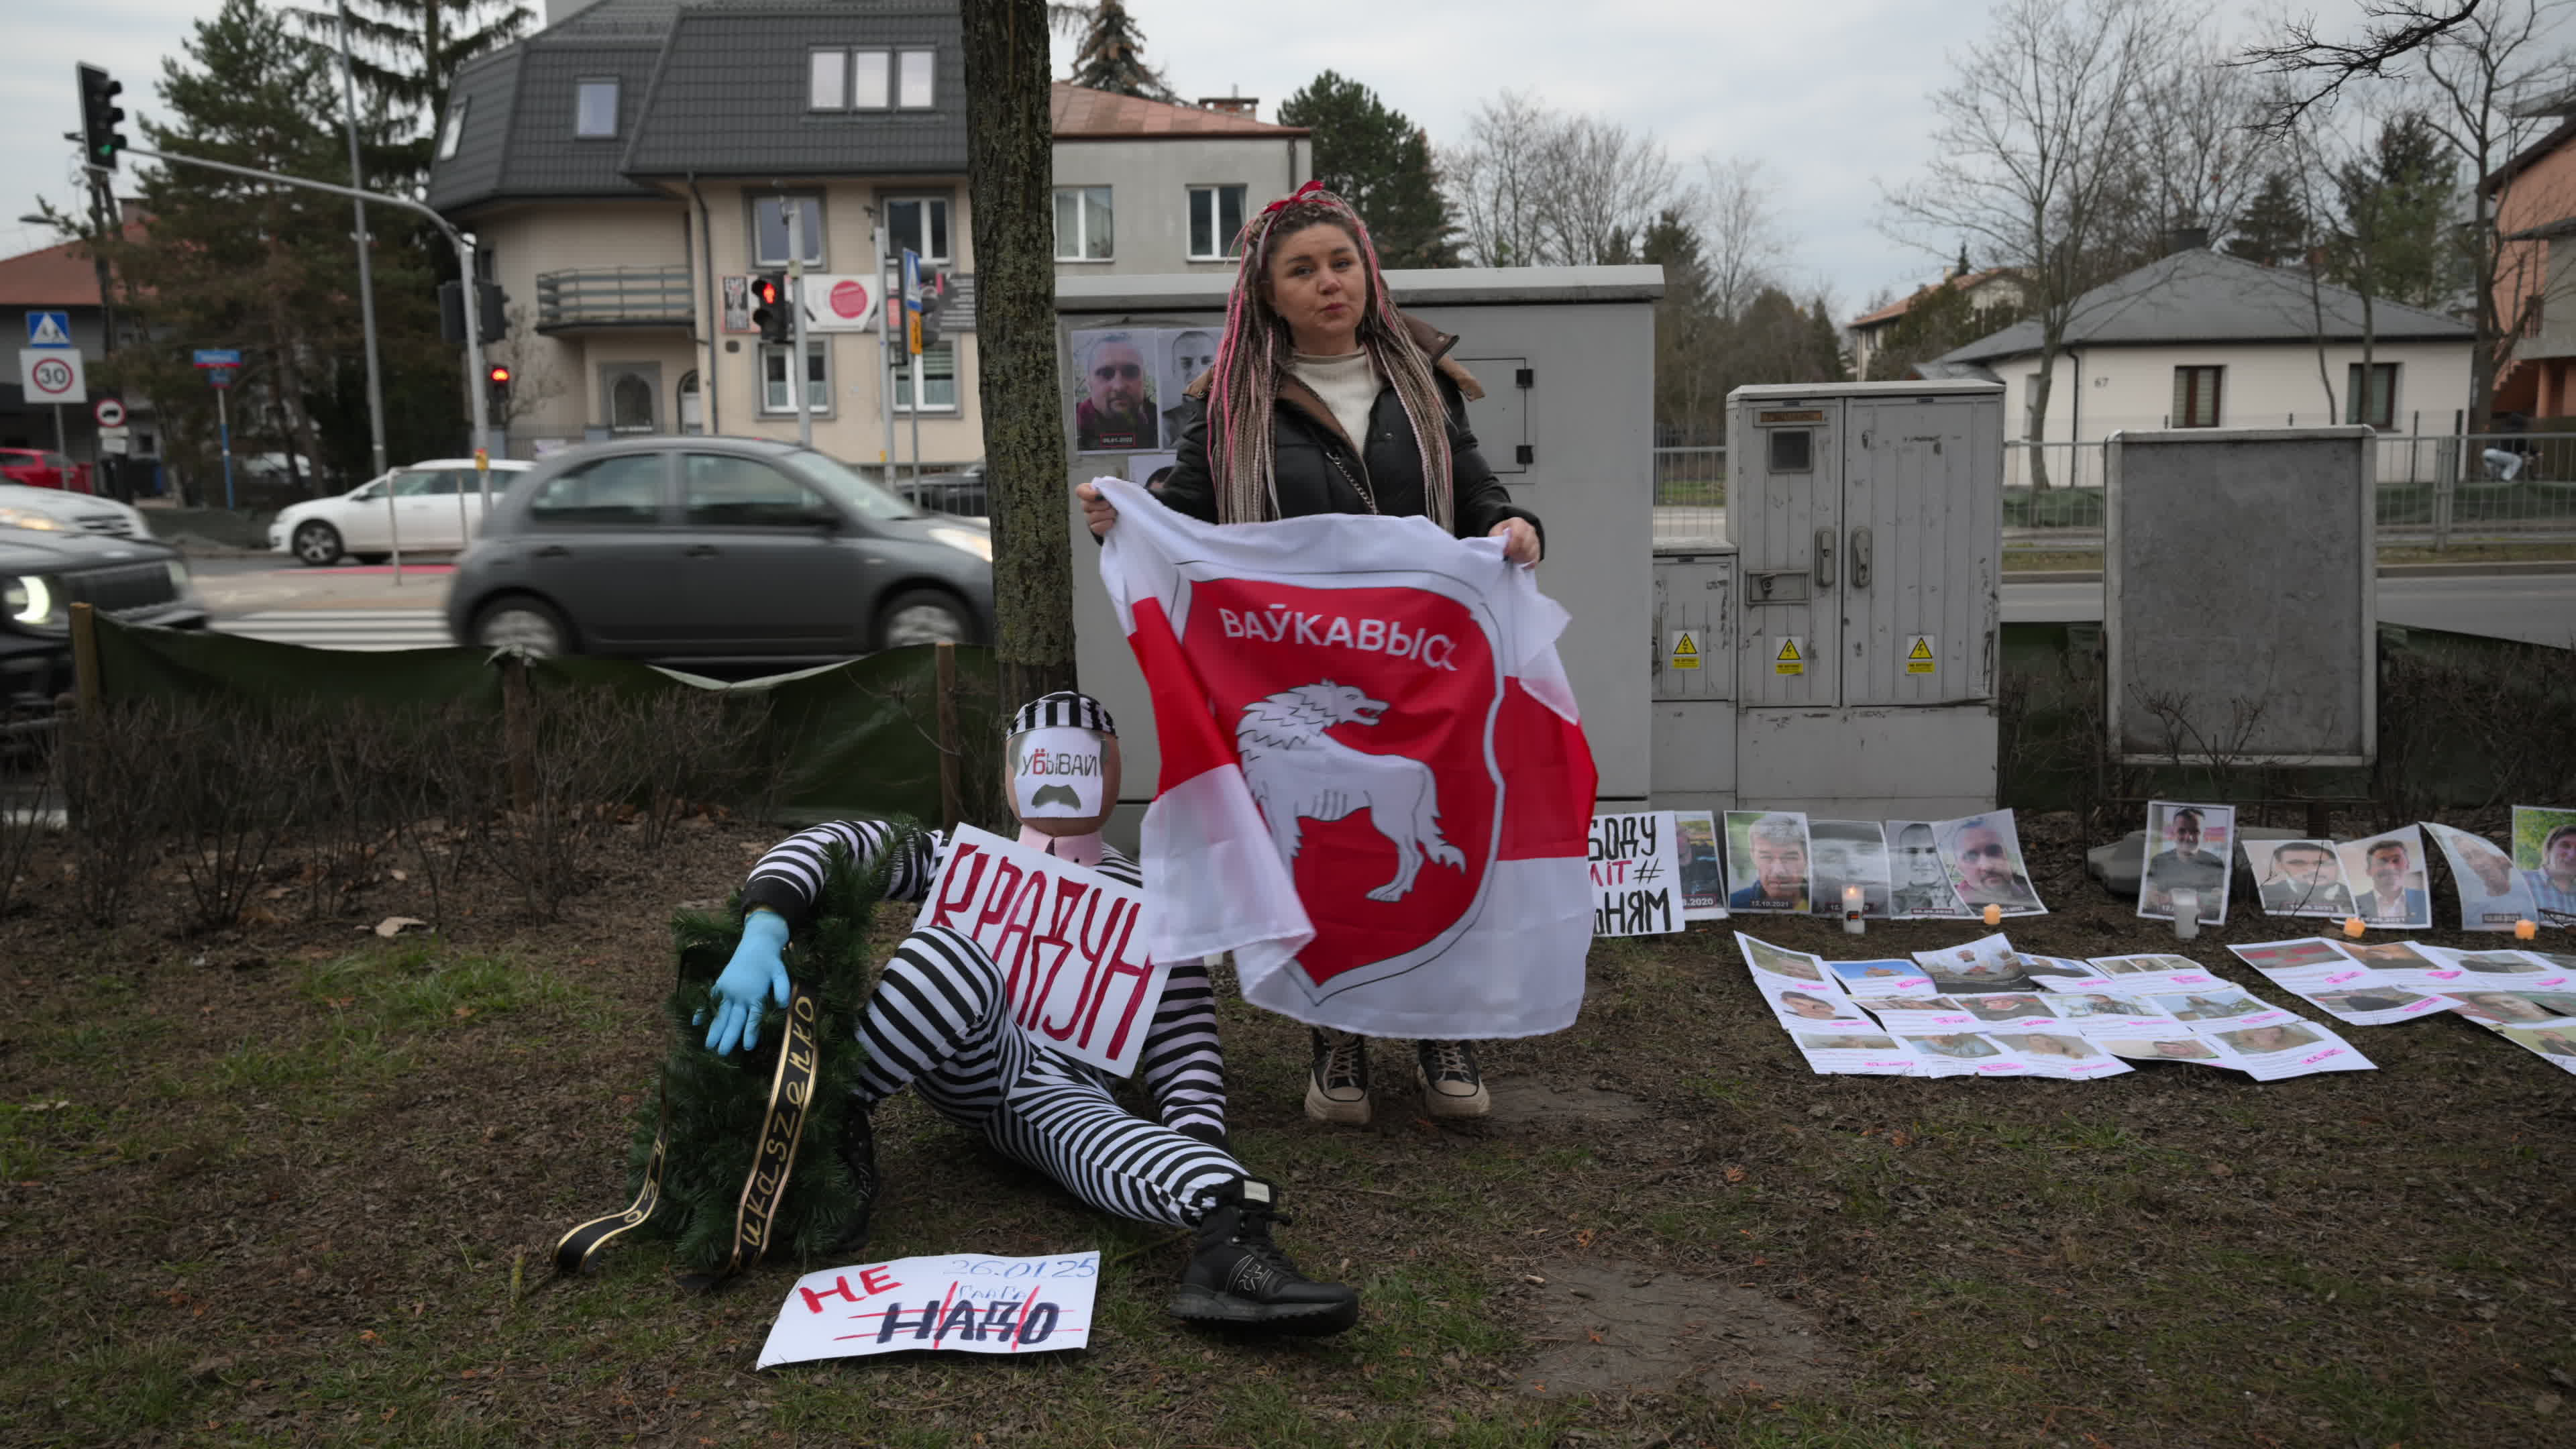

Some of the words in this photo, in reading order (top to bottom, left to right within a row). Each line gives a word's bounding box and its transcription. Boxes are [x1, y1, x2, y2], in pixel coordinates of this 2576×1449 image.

[39, 368, 66, 384] 30
[2094, 377, 2110, 388] 67
[930, 843, 1155, 1061] КРАДУН
[799, 1265, 904, 1313] НЕ
[876, 1299, 1060, 1344] НАДО
